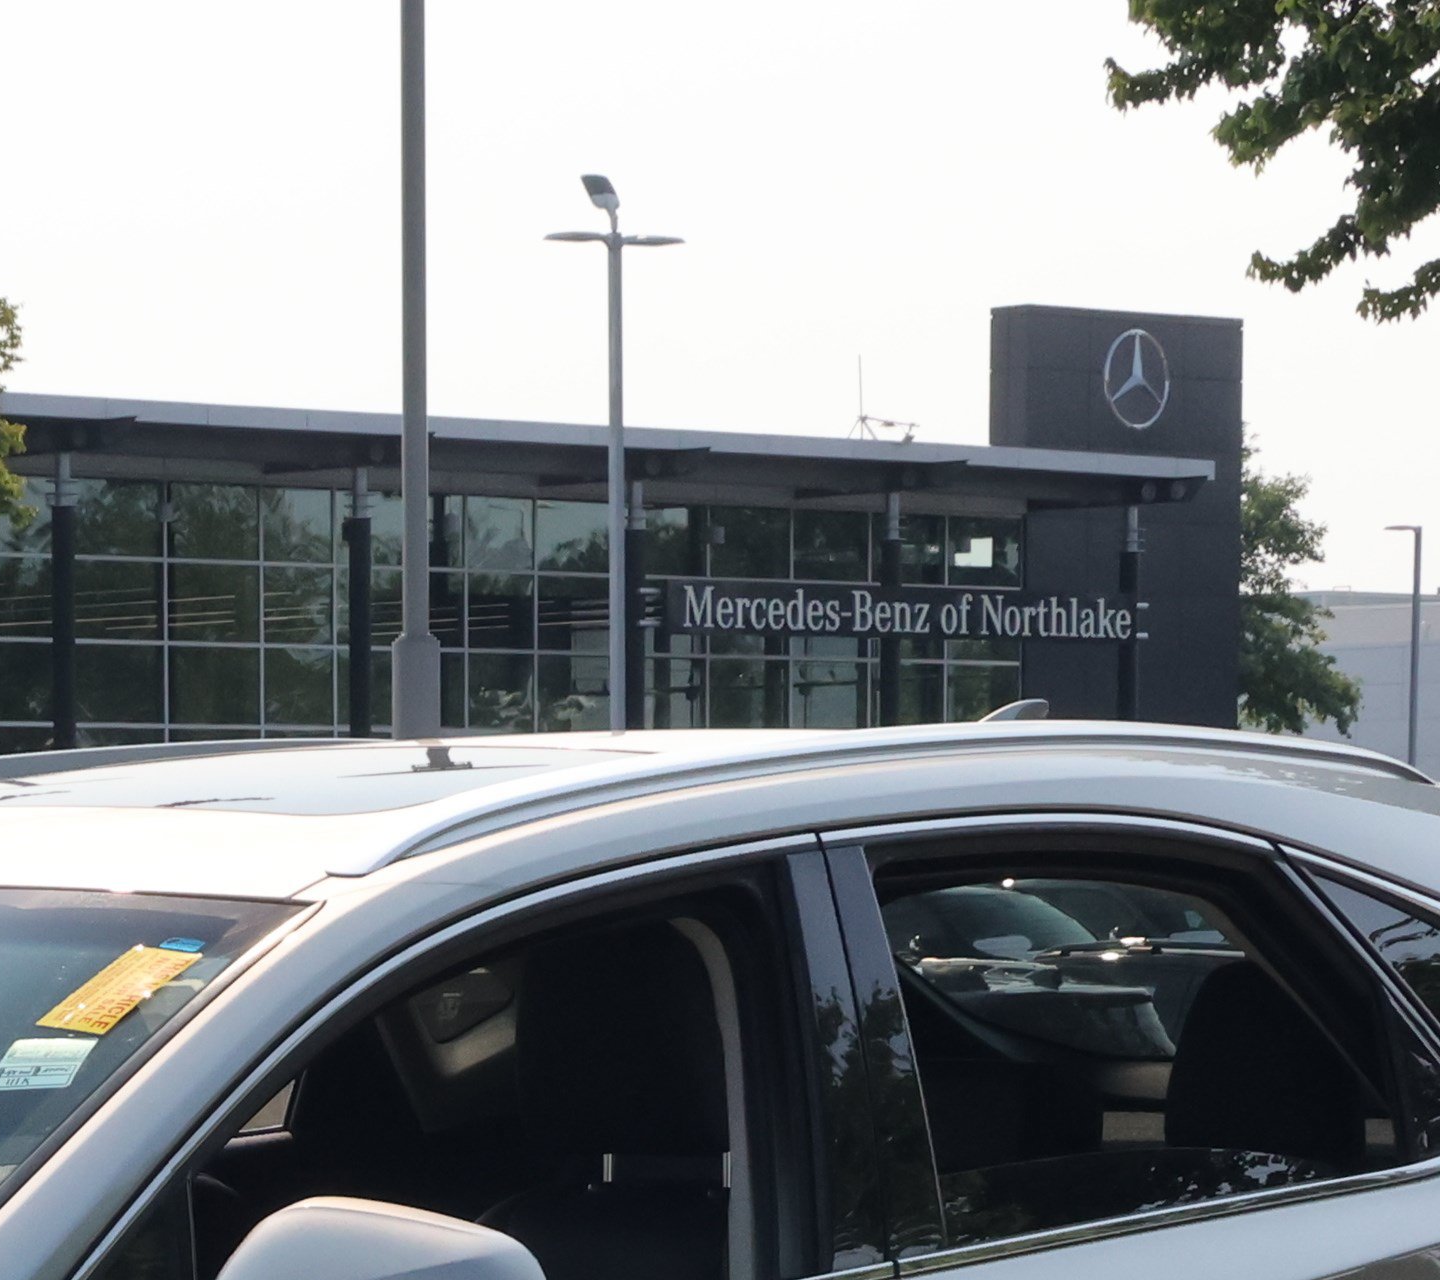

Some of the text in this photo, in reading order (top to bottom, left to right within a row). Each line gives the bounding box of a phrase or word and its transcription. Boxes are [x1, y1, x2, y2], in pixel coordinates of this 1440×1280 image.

[683, 584, 1132, 639] Mercedes-Benz of Northlake
